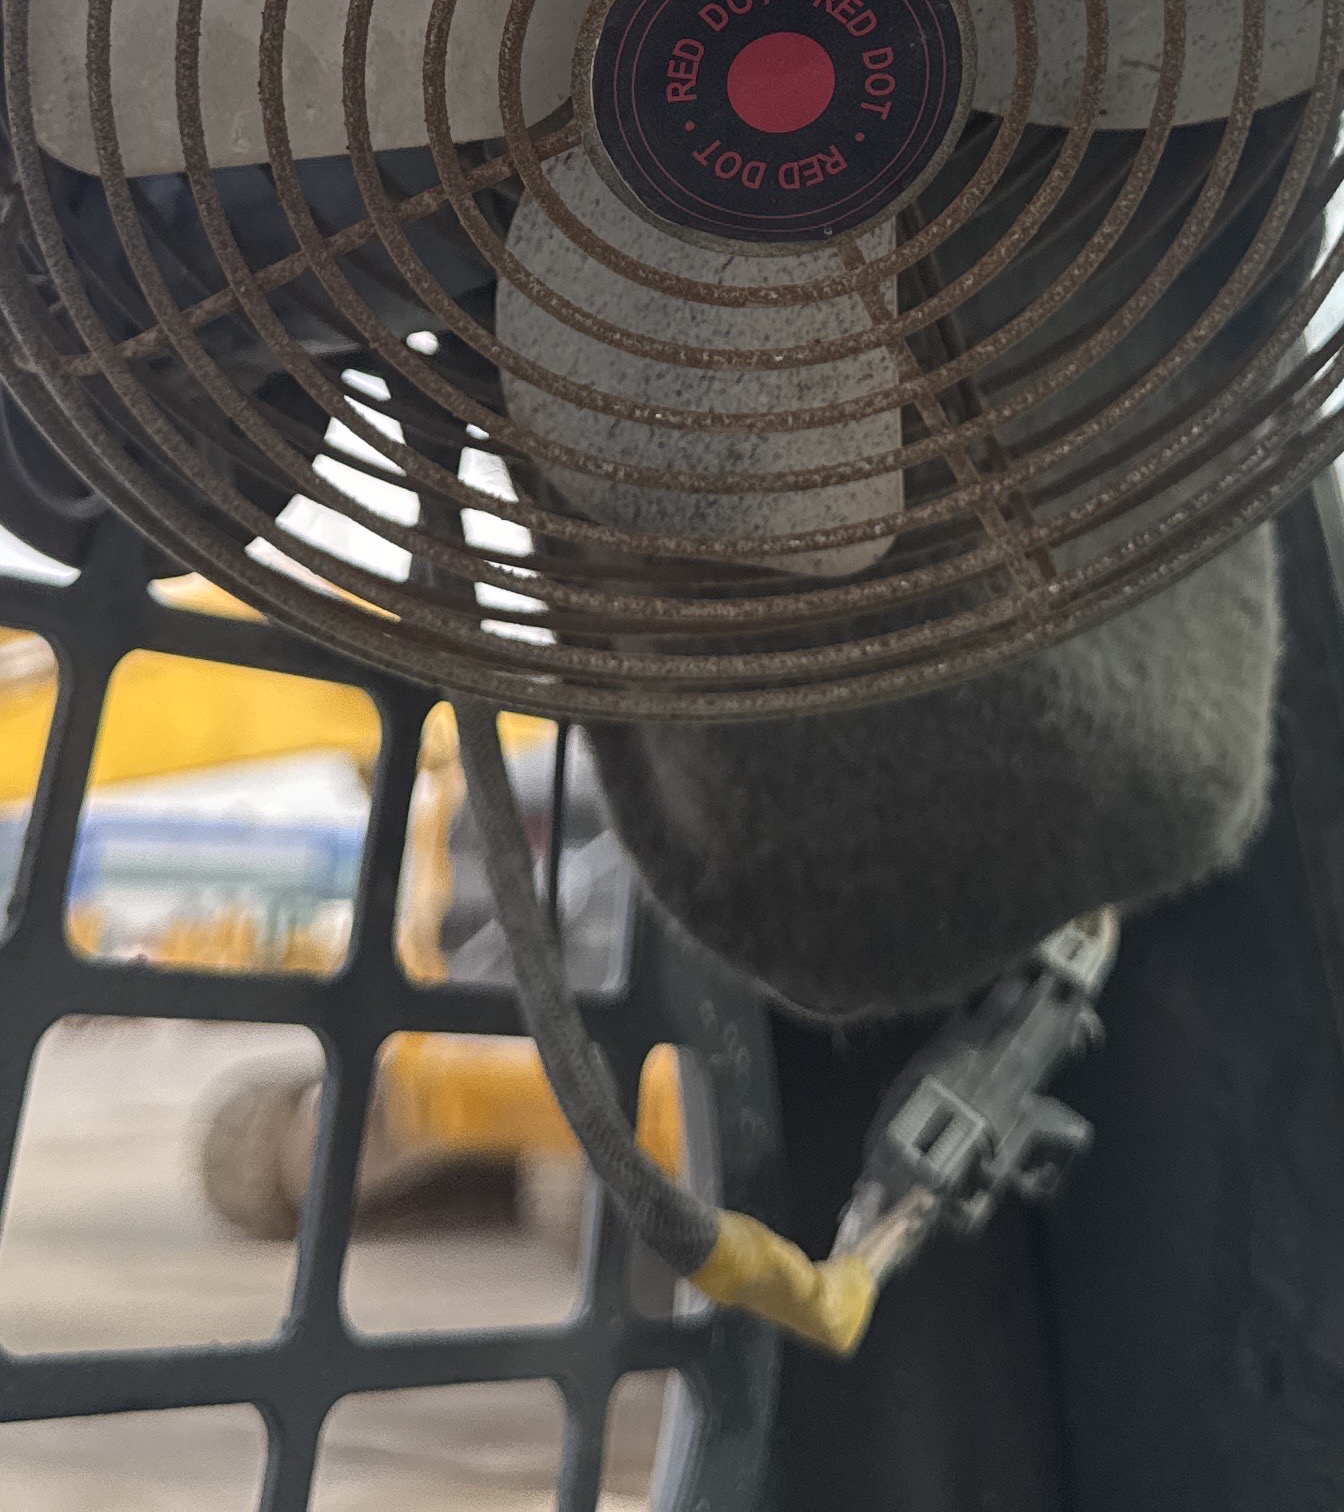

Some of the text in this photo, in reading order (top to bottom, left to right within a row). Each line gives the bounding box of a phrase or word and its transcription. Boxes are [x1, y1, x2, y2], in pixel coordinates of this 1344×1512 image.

[666, 38, 705, 103] RED
[861, 46, 896, 120] DOT
[692, 140, 848, 190] RED DOT
